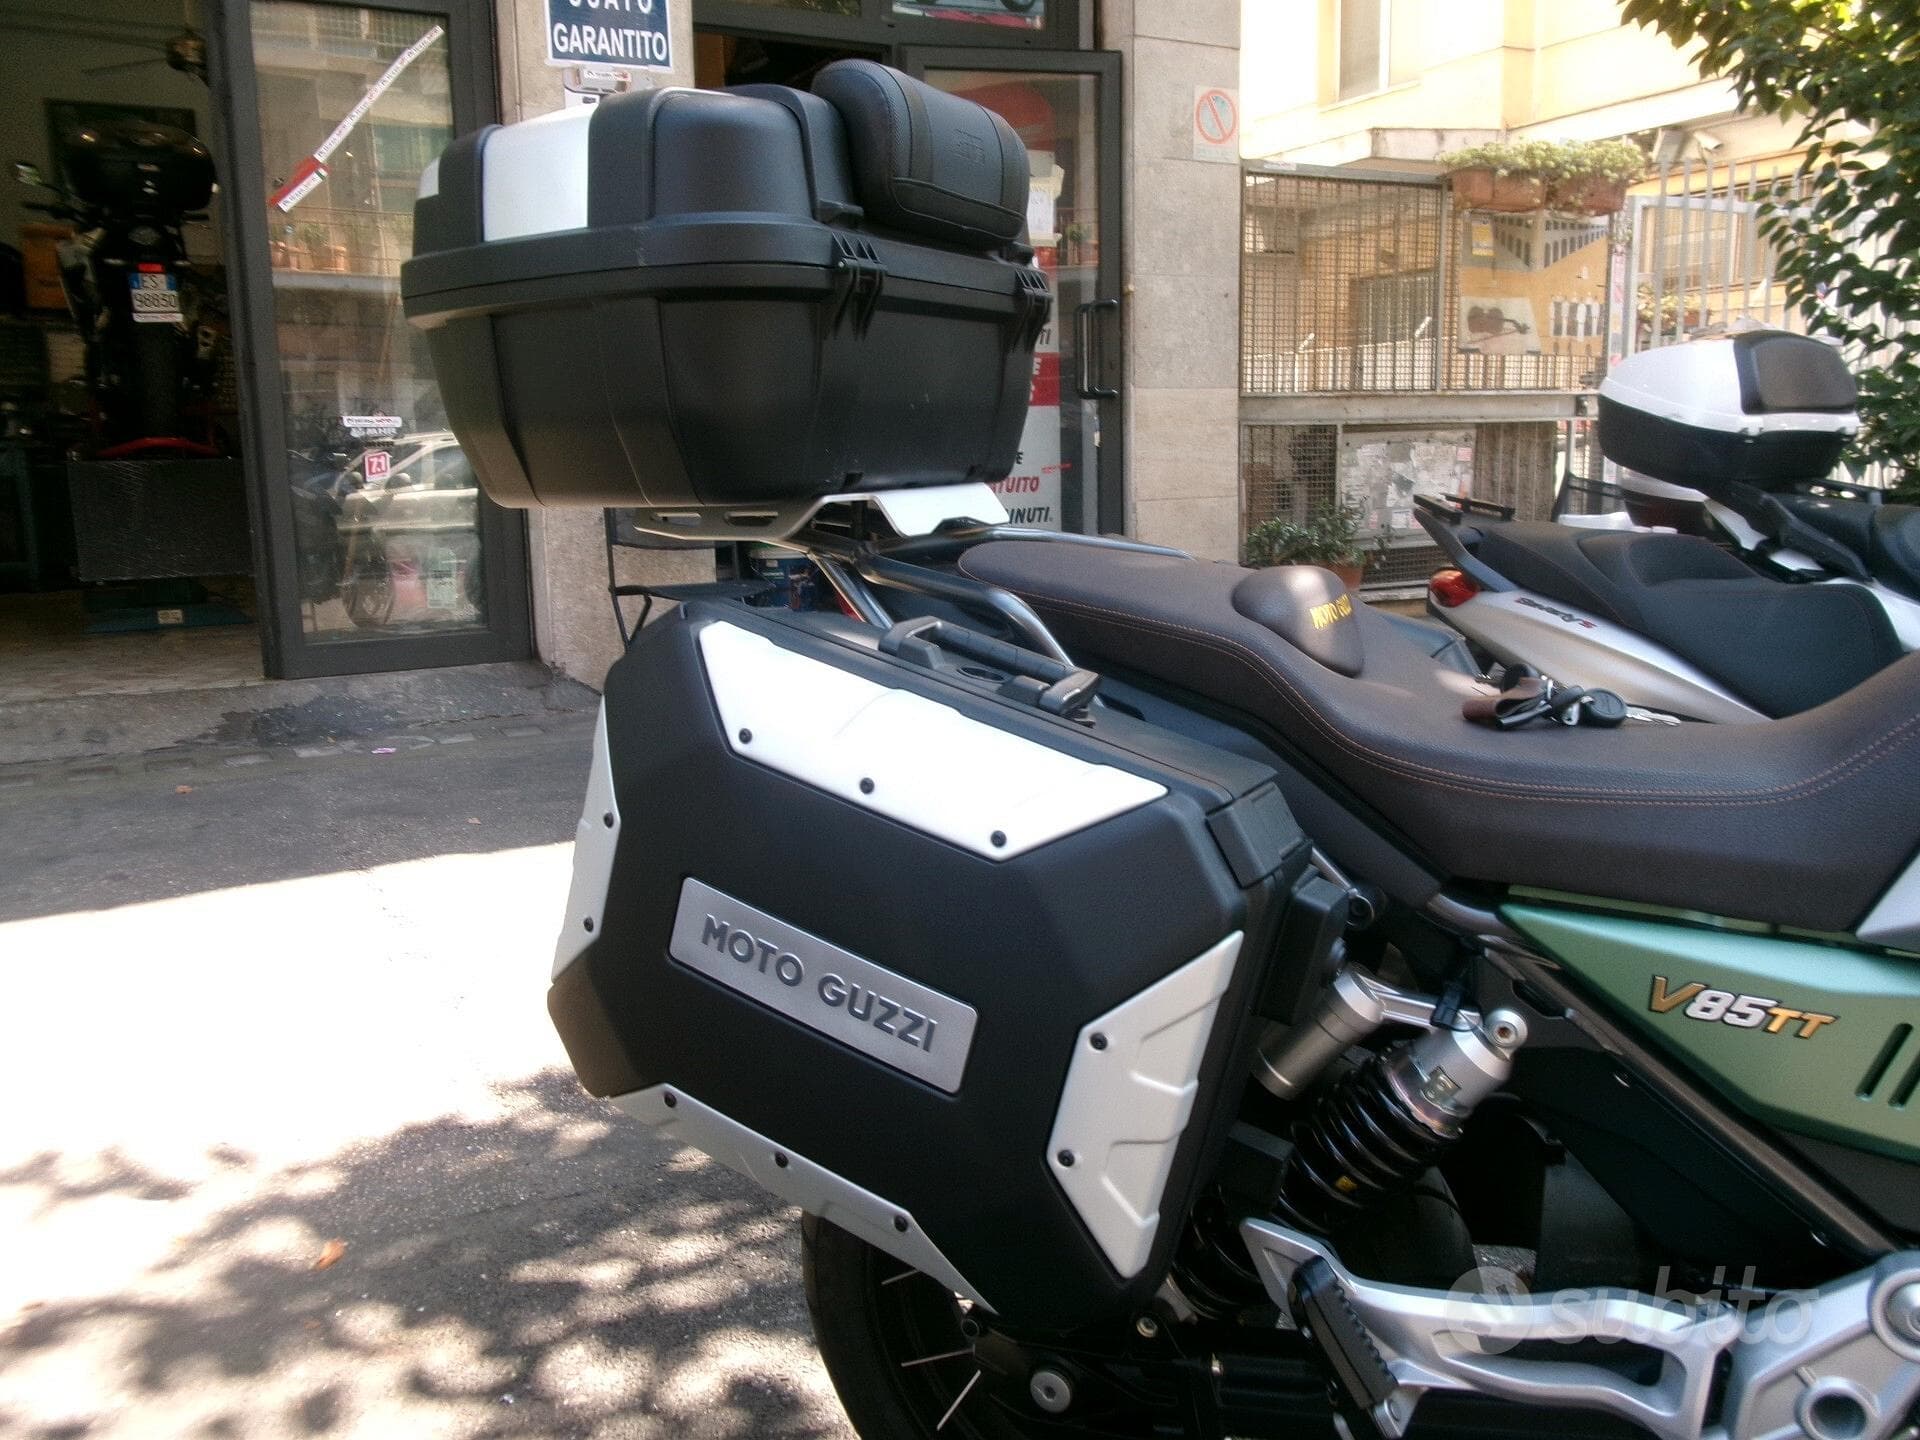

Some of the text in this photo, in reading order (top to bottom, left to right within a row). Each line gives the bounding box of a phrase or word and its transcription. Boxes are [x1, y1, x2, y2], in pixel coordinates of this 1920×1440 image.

[553, 23, 667, 61] GARANTITO
[992, 476, 1040, 493] TUITO
[1005, 507, 1054, 524] INUTI.
[701, 913, 939, 1053] MOTO GUZZI
